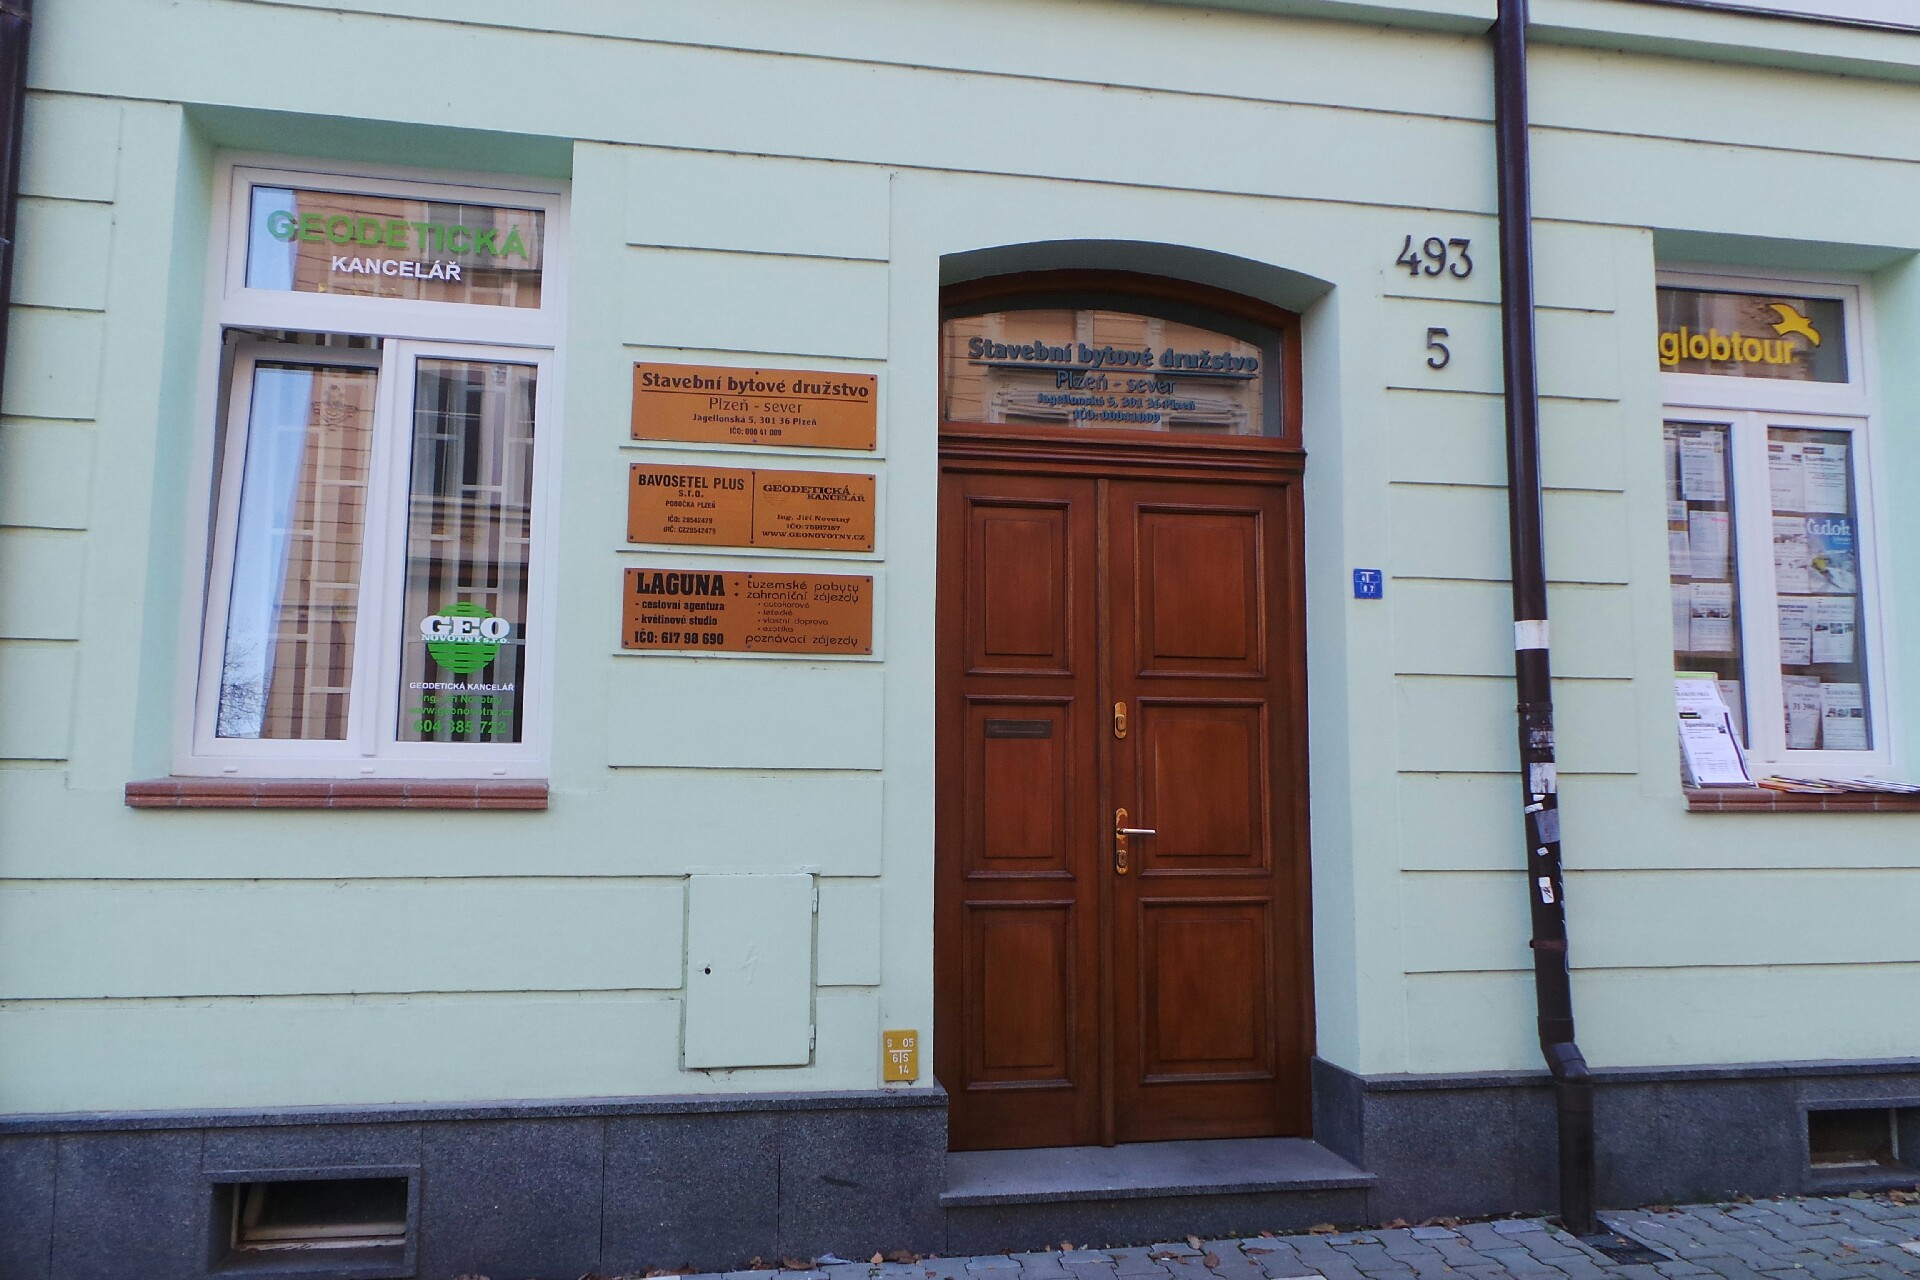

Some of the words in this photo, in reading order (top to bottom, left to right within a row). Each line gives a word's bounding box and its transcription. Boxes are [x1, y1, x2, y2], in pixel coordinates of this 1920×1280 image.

[267, 209, 528, 261] GEODETICKÁ
[1397, 234, 1474, 279] 493
[331, 255, 462, 281] KANCELÁŘ
[1427, 327, 1450, 370] 5
[1659, 326, 1796, 366] globtour
[967, 335, 1073, 362] Stavební
[1078, 343, 1155, 369] bytové
[1159, 349, 1259, 373] družstvo
[642, 372, 722, 390] Stavební
[727, 376, 786, 394] bytové
[792, 380, 869, 397] družstvo
[1056, 370, 1109, 391] Plzeň
[1126, 378, 1177, 395] sever
[709, 397, 749, 412] Plzeň
[763, 401, 803, 414] sever
[692, 413, 746, 424] Jagellonská
[748, 415, 757, 425] 5,
[759, 416, 776, 425] 301
[779, 417, 790, 425] 36
[792, 418, 817, 426] Plzeň
[729, 427, 744, 435] IČO:
[638, 474, 709, 489] BAVOSETEL
[713, 477, 745, 490] PLUS
[678, 489, 704, 498] s.r.o.
[762, 484, 851, 496] GEODETICKÁ
[665, 499, 695, 508] POBOČKA
[697, 500, 716, 509] PLZEŇ
[806, 493, 866, 502] KANCELÁŘ
[814, 515, 851, 524] Novotný
[636, 572, 726, 597] LAGUNA
[747, 580, 808, 591] tuzemské
[814, 582, 860, 594] pobyty
[746, 590, 808, 600] zahraniční
[813, 592, 859, 605] zájezdy
[642, 599, 681, 610] cestovní
[683, 601, 725, 613] agentura
[420, 614, 511, 640] GEO
[641, 614, 687, 625] květinové
[688, 615, 718, 626] studio
[634, 628, 658, 644] IČO:
[661, 631, 681, 644] 617
[683, 632, 699, 645] 98
[702, 632, 725, 645] 690
[745, 634, 807, 645] poznávací
[812, 634, 859, 648] zájezdy
[409, 681, 466, 690] GEODETICKÁ
[467, 682, 515, 691] KANCELÁŘ
[902, 1037, 915, 1048] 05
[892, 1053, 899, 1063] 6
[899, 1064, 909, 1075] 14
